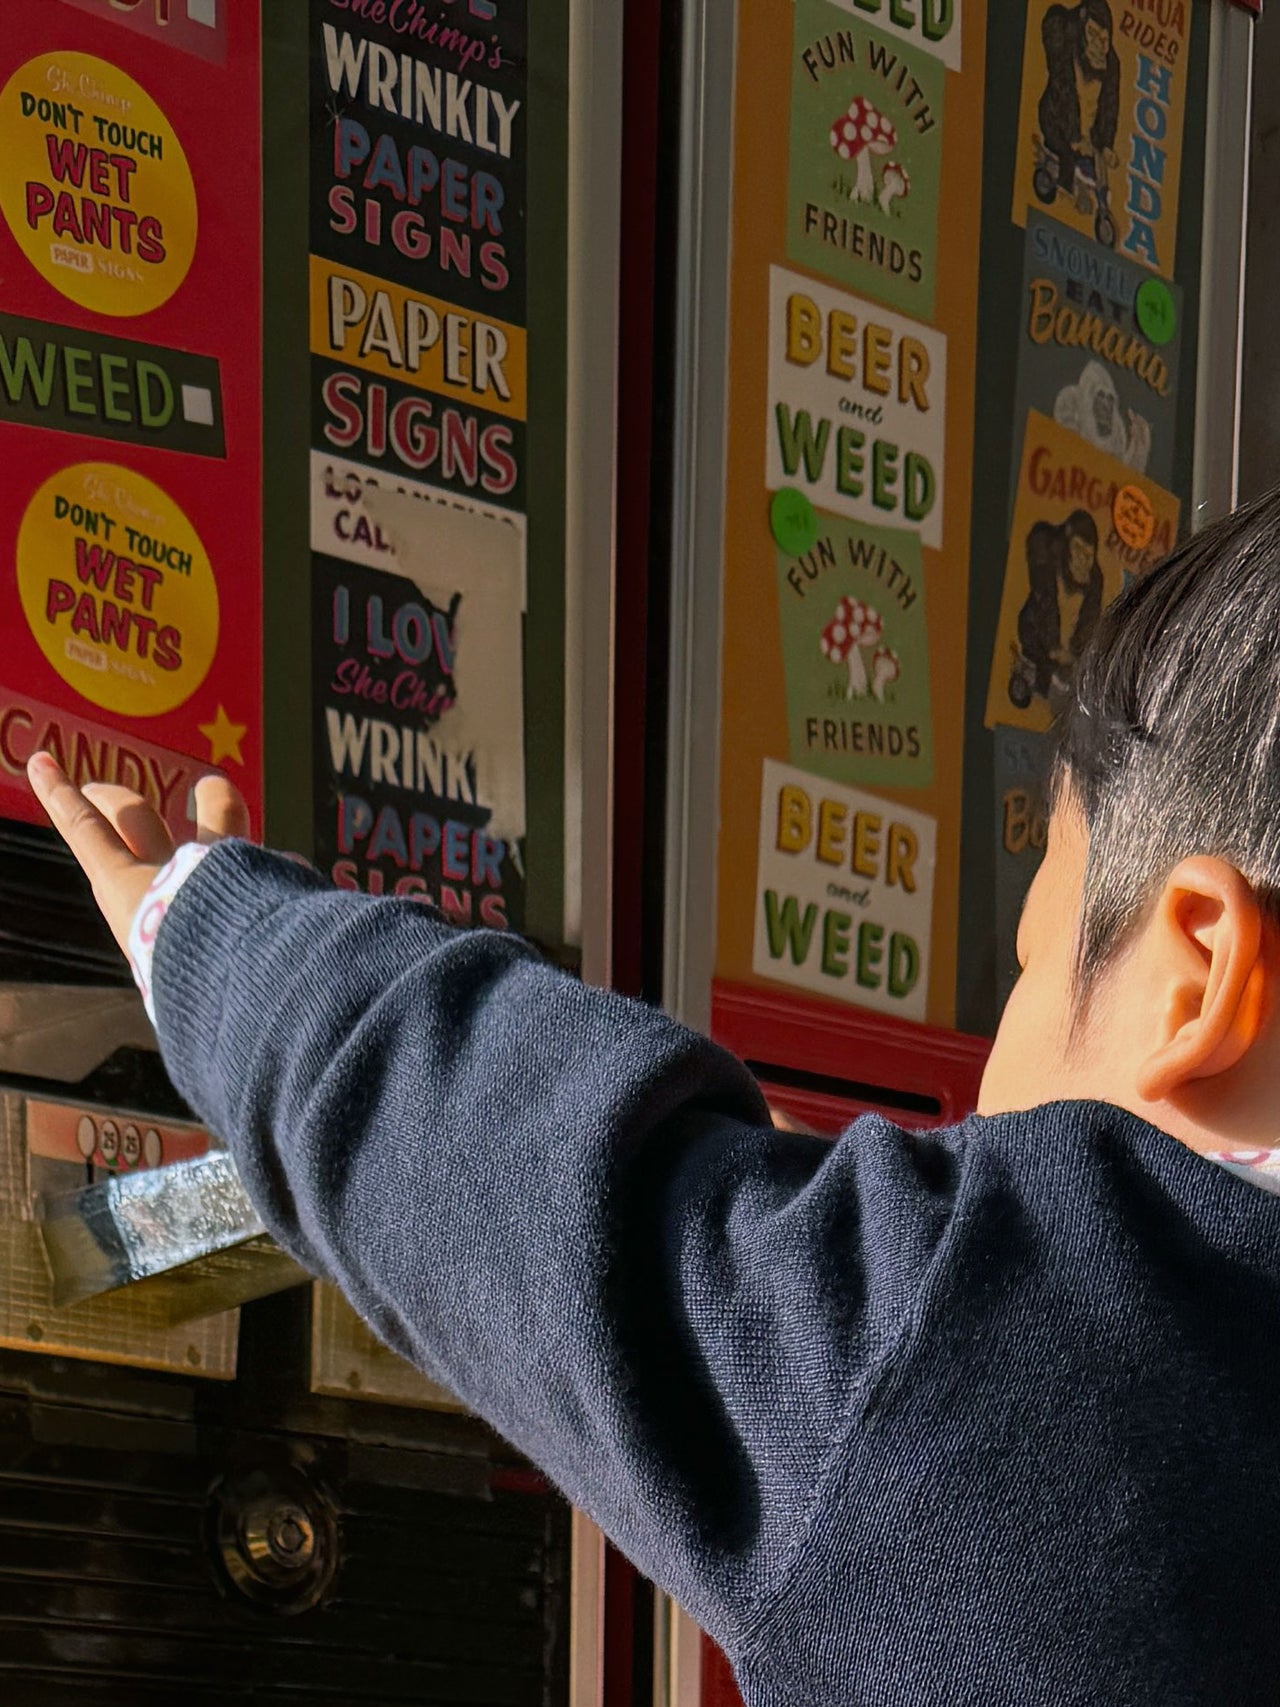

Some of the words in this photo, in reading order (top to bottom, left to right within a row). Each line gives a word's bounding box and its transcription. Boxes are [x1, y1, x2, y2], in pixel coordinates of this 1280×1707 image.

[802, 31, 854, 82] FUN
[869, 40, 935, 134] WITH
[1121, 11, 1180, 66] RIDES
[20, 91, 83, 134] DON'T
[93, 115, 163, 160] TOUCH
[323, 22, 520, 158] WRINKLY
[46, 134, 137, 203] WET
[333, 117, 504, 235] PAPER
[1123, 52, 1173, 270] HONDA
[25, 181, 166, 264] PANTS
[328, 184, 509, 291] SIGNS
[804, 203, 923, 283] FRIENDS
[327, 274, 511, 402] PAPER
[786, 293, 931, 412] BEER
[1029, 278, 1169, 398] Banana
[322, 372, 517, 493] SIGNS
[839, 397, 883, 425] and
[775, 401, 936, 521] WEED
[54, 496, 116, 540] DON'T
[125, 526, 192, 577] TOUCH
[75, 537, 163, 611] WET
[786, 537, 837, 597] FUN
[848, 537, 917, 609] WITH
[46, 578, 182, 672] PANTS
[334, 585, 349, 645] I
[367, 595, 456, 675] LOV
[325, 707, 477, 806] WRINK
[805, 718, 921, 758] FRIENDS
[337, 795, 505, 888] PAPER
[776, 784, 918, 894] BEER
[764, 889, 919, 999] WEED
